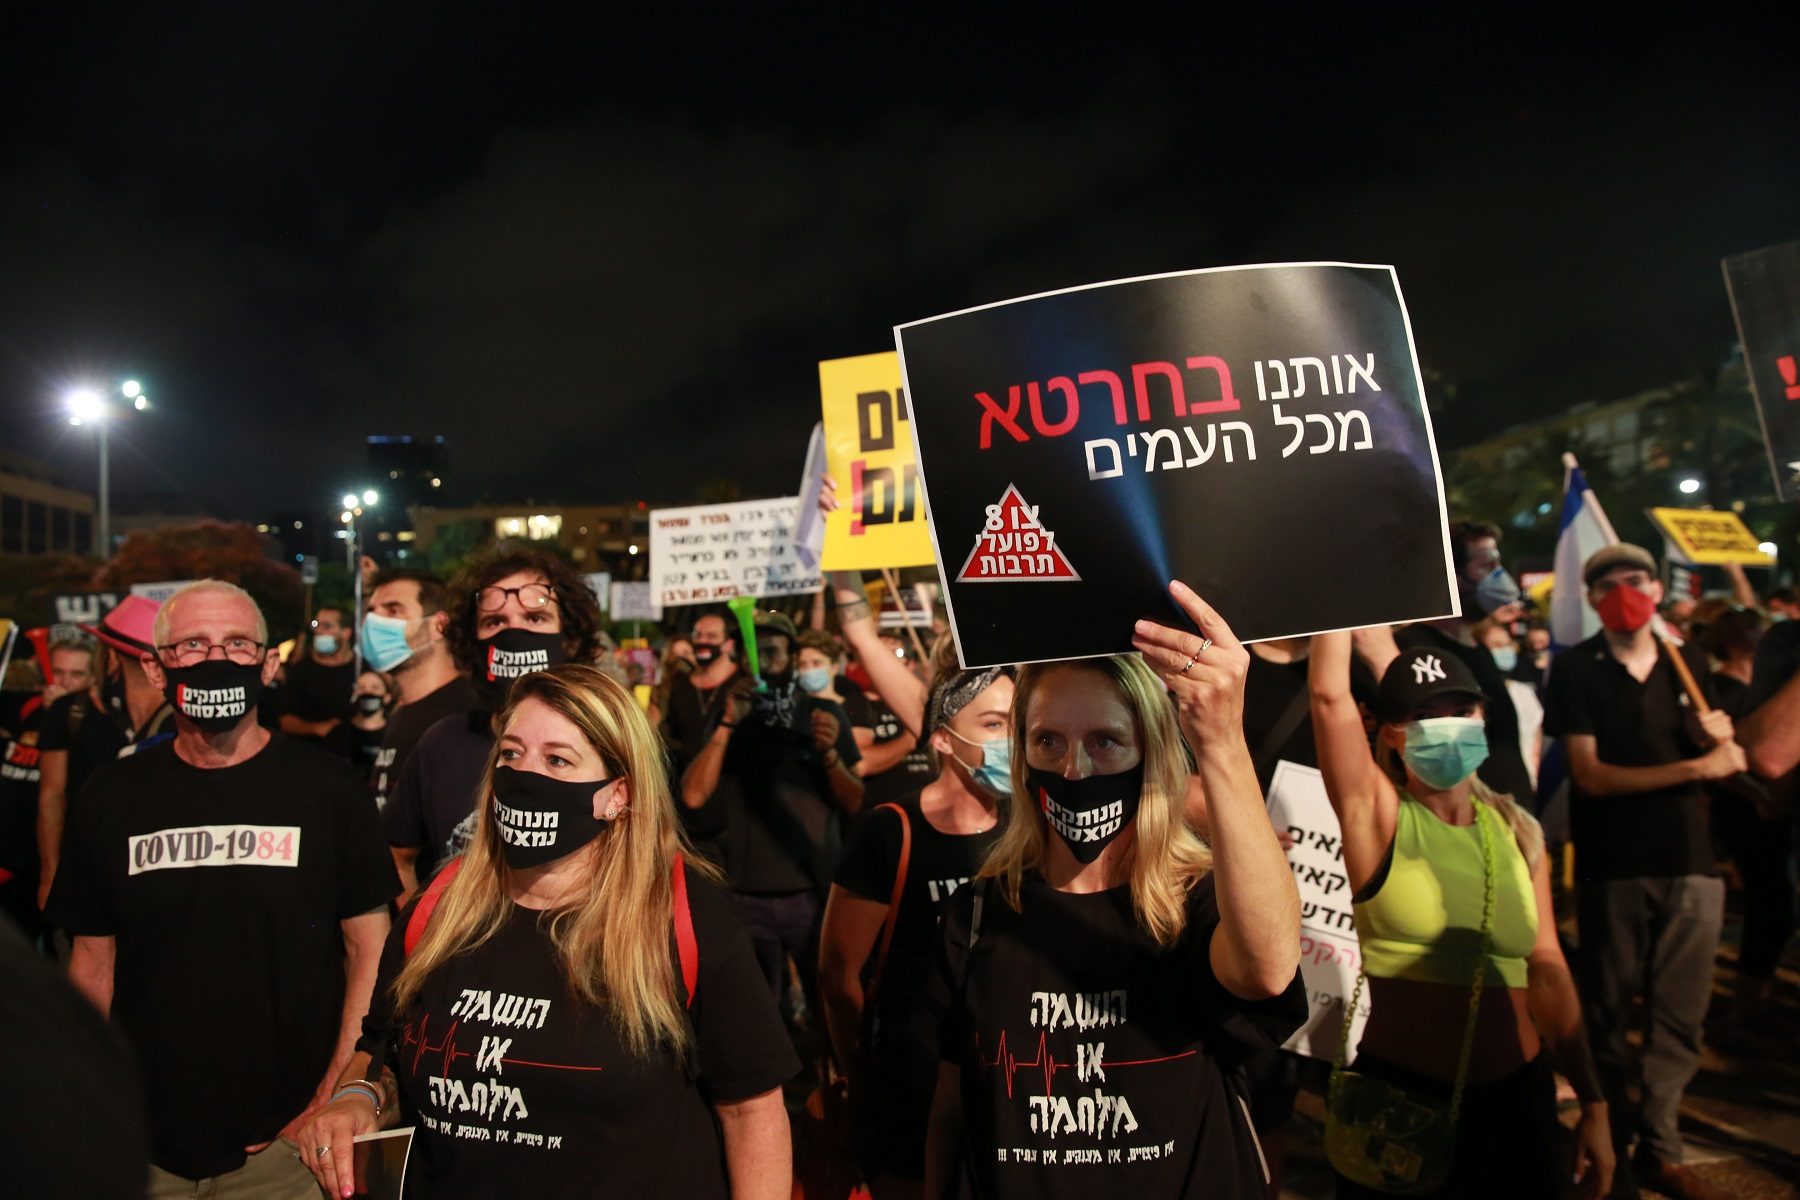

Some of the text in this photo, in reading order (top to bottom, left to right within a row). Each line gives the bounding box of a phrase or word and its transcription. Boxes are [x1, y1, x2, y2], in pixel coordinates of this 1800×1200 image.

[974, 353, 1382, 450] אותנו בחרטא
[1084, 404, 1373, 481] מכל העמים
[985, 504, 1041, 531] צו 8
[975, 528, 1054, 553] לפועלי
[980, 554, 1055, 575] תרבות
[493, 648, 549, 665] מנותקים
[1411, 655, 1447, 684] NY
[182, 686, 245, 704] מנותקים
[1046, 795, 1122, 826] מנותקים
[135, 830, 293, 868] COVID-1984
[450, 989, 551, 1029] הנשמה
[1030, 990, 1127, 1033] הנשמה
[476, 1036, 512, 1075] או
[1077, 1042, 1105, 1082] או
[429, 1076, 529, 1122] מלחמה
[1030, 1088, 1138, 1140] מלחמה
[440, 1121, 452, 1136] אין
[496, 1129, 510, 1143] אין
[548, 1136, 562, 1150] אין
[1013, 1148, 1037, 1162] עתיד
[1043, 1149, 1057, 1165] אין
[1108, 1148, 1121, 1164] אין
